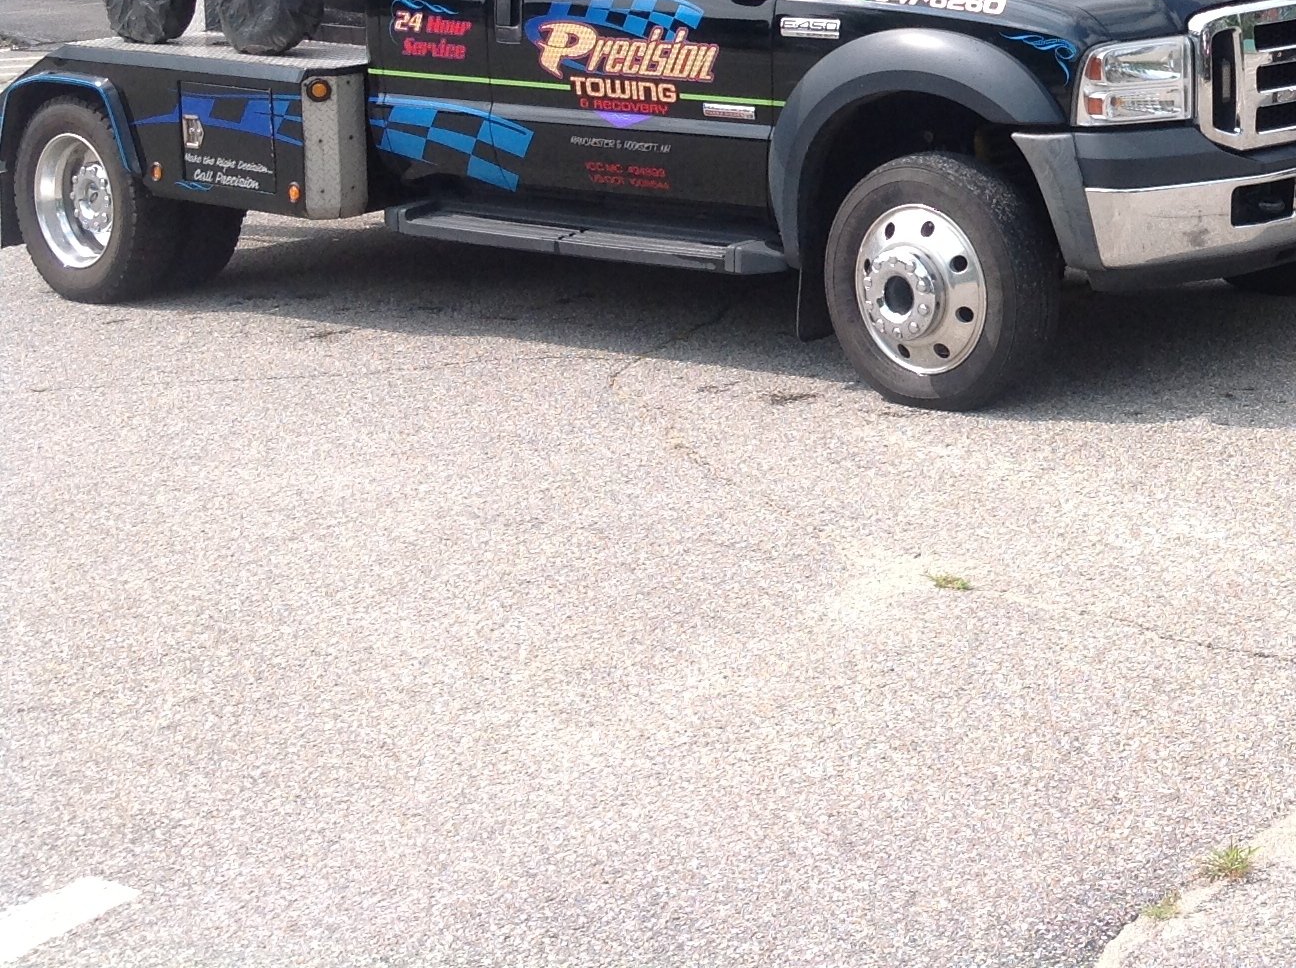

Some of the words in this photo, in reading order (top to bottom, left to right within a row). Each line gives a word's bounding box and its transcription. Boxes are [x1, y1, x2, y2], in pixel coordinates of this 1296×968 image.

[394, 10, 423, 32] 24
[426, 15, 472, 36] Hour
[402, 36, 466, 60] Service
[537, 20, 719, 82] Precision
[570, 76, 677, 103] TOWING
[580, 98, 588, 108] &
[594, 99, 669, 115] RECOVERY
[185, 153, 201, 163] Make
[203, 155, 215, 165] the
[216, 157, 236, 173] Right
[194, 169, 213, 182] Call
[215, 172, 260, 189] Precision
